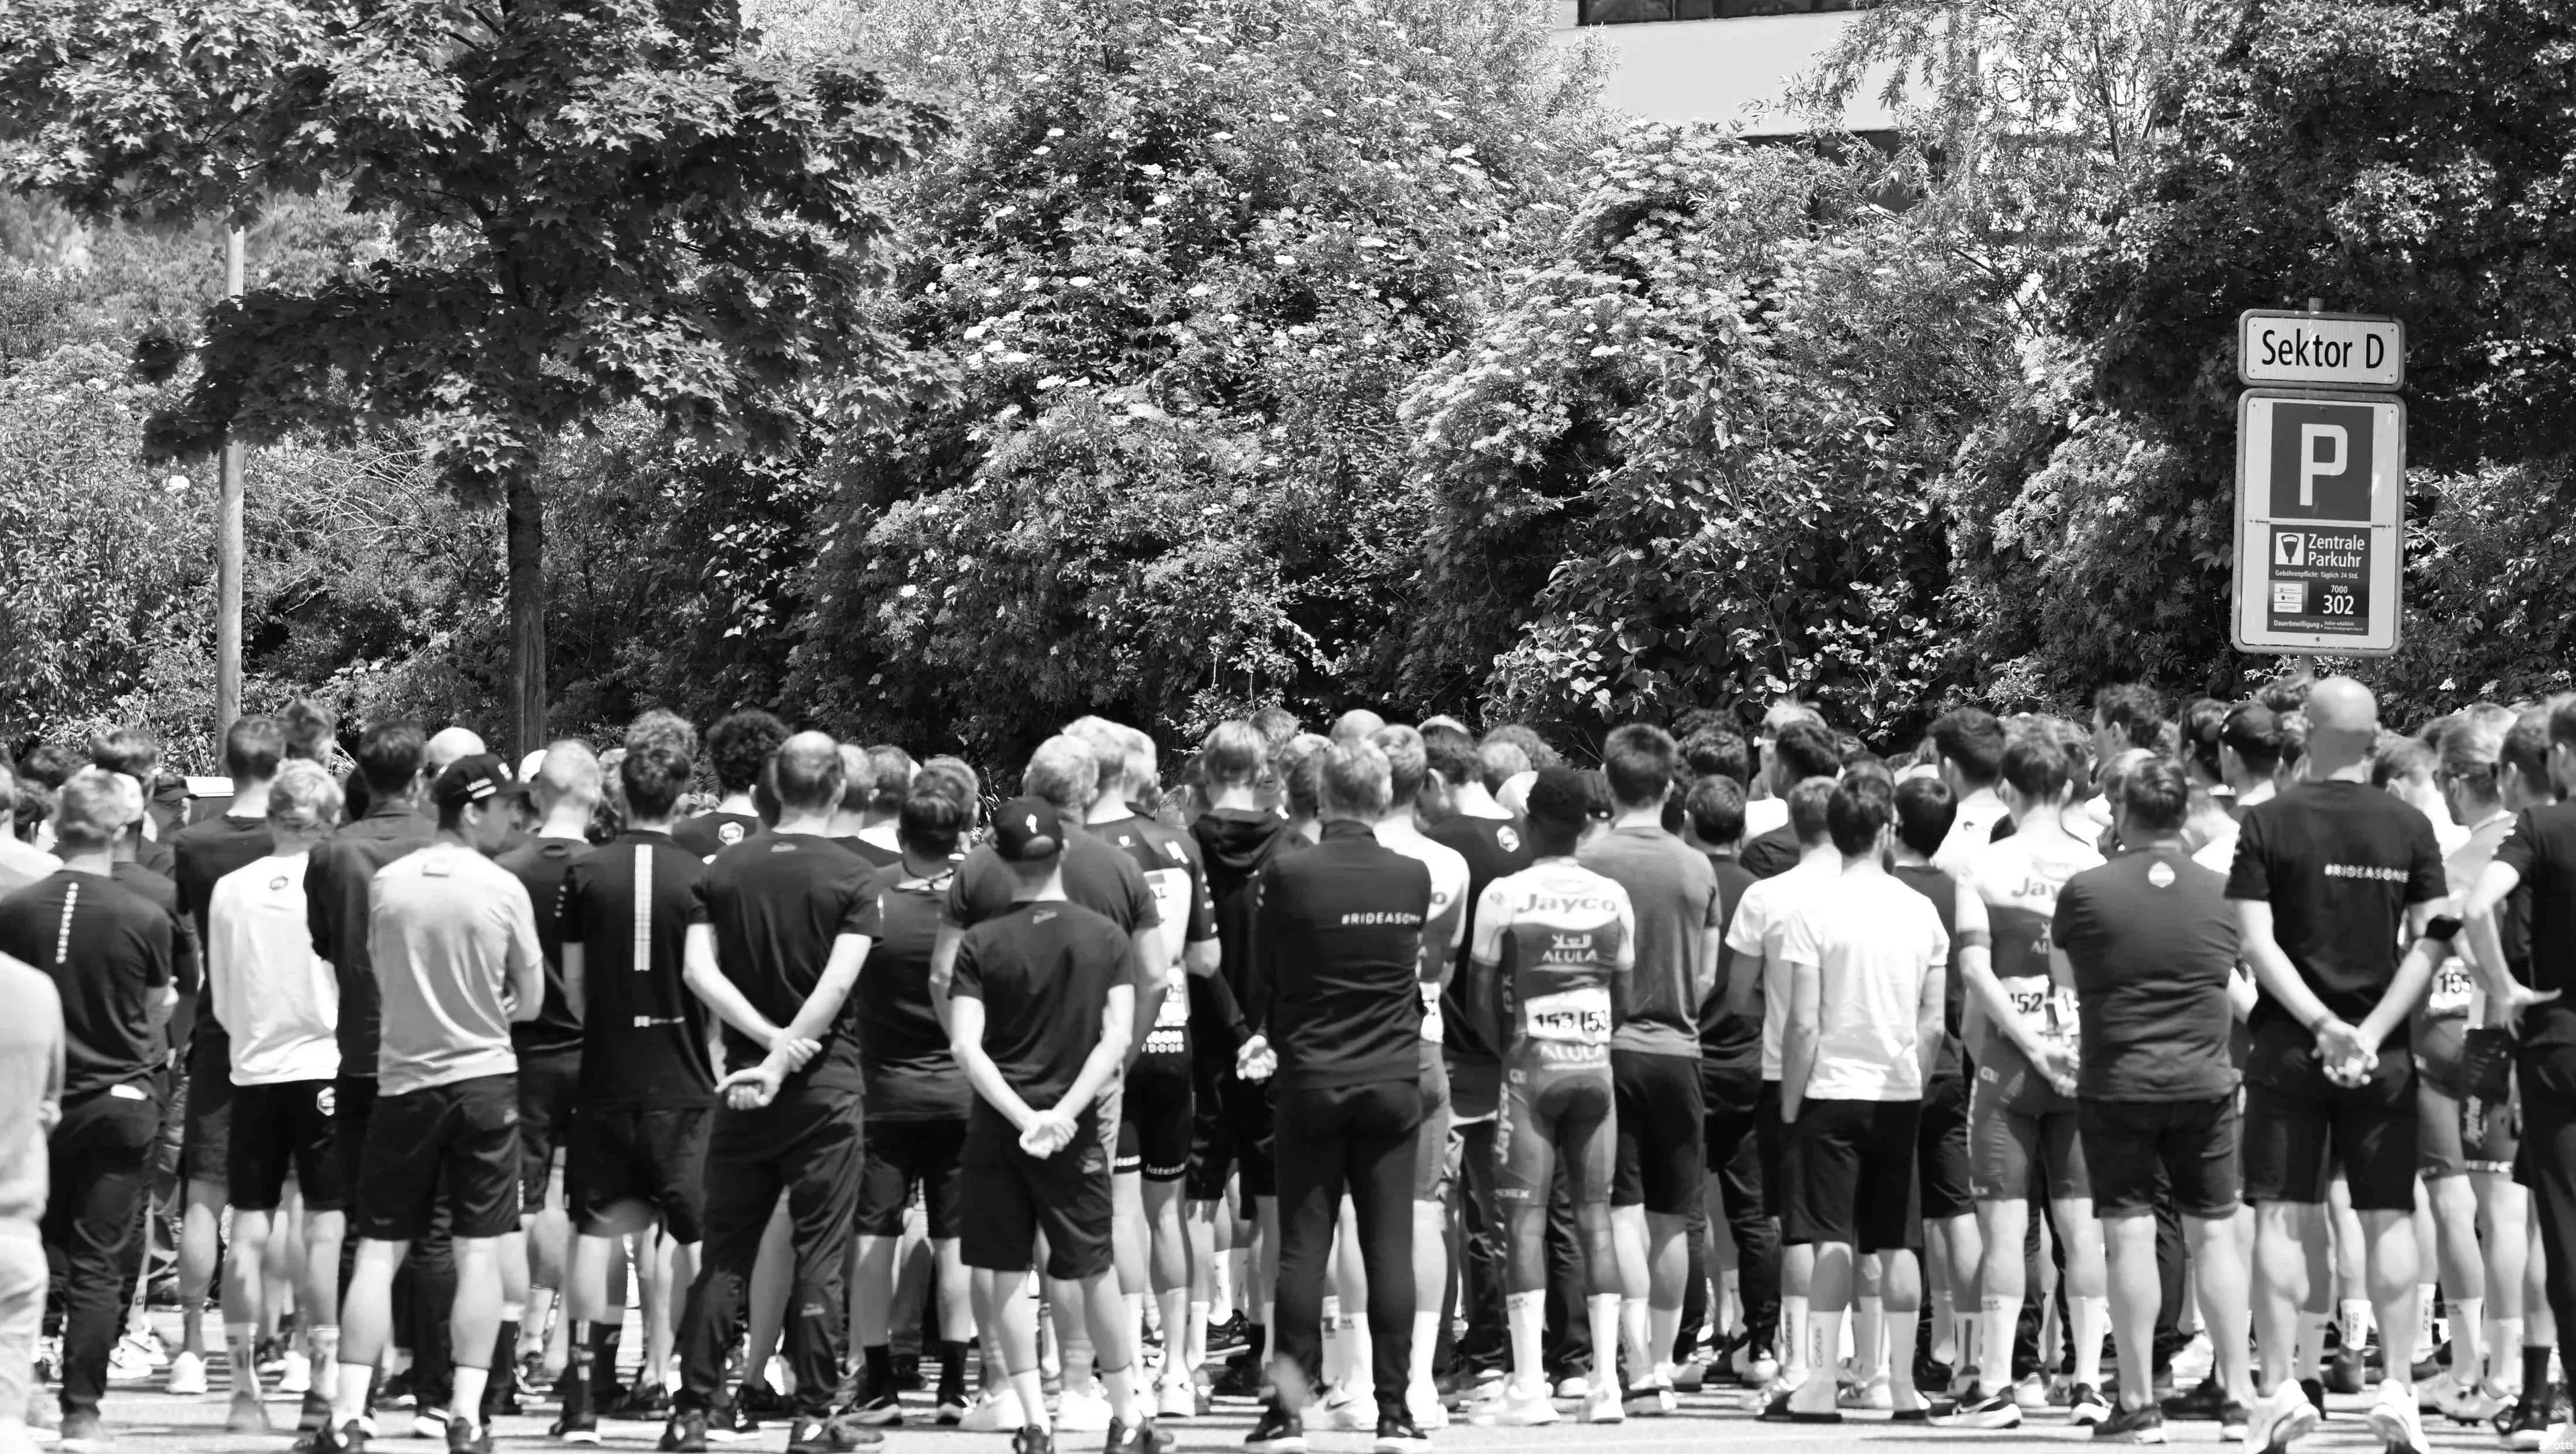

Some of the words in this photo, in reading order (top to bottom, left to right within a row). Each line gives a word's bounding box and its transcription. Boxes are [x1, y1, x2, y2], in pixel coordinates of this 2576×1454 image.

[2261, 328, 2353, 368] Sektor
[2365, 333, 2384, 369] D
[2299, 423, 2348, 506] P
[2308, 533, 2365, 551] Zentrale
[2308, 551, 2362, 568] Parkuhr
[2330, 585, 2348, 594] 7000
[2322, 594, 2355, 615] 302
[1517, 893, 1617, 915] Jayco
[1542, 949, 1598, 963] ALULA
